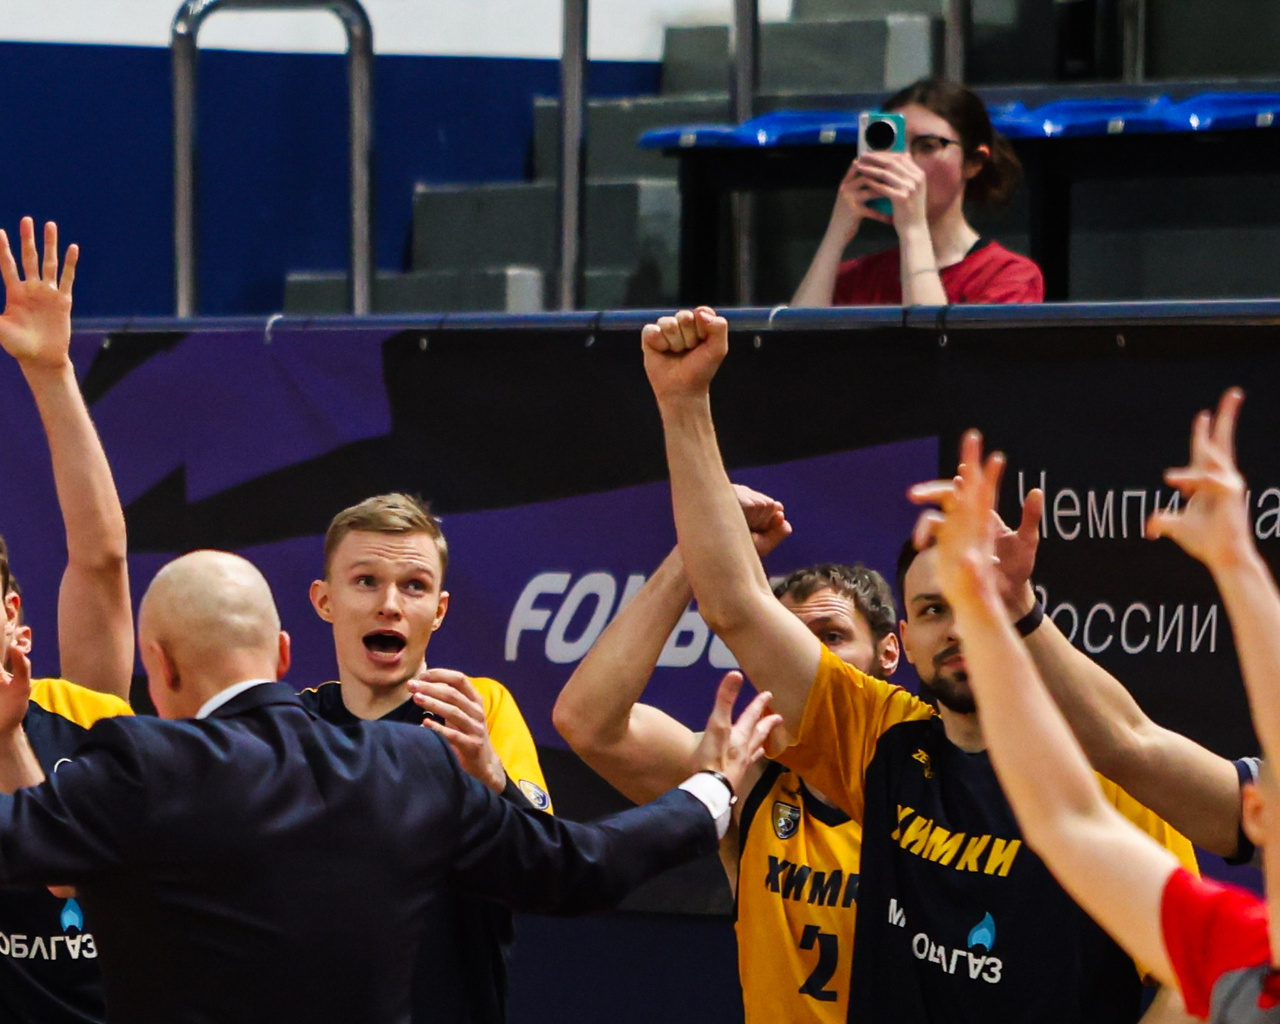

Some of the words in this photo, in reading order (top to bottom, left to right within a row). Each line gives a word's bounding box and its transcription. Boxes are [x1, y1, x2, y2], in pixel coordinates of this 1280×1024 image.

[1036, 584, 1218, 654] оссии
[891, 804, 1022, 877] ХИМКИ
[798, 924, 839, 1002] 2
